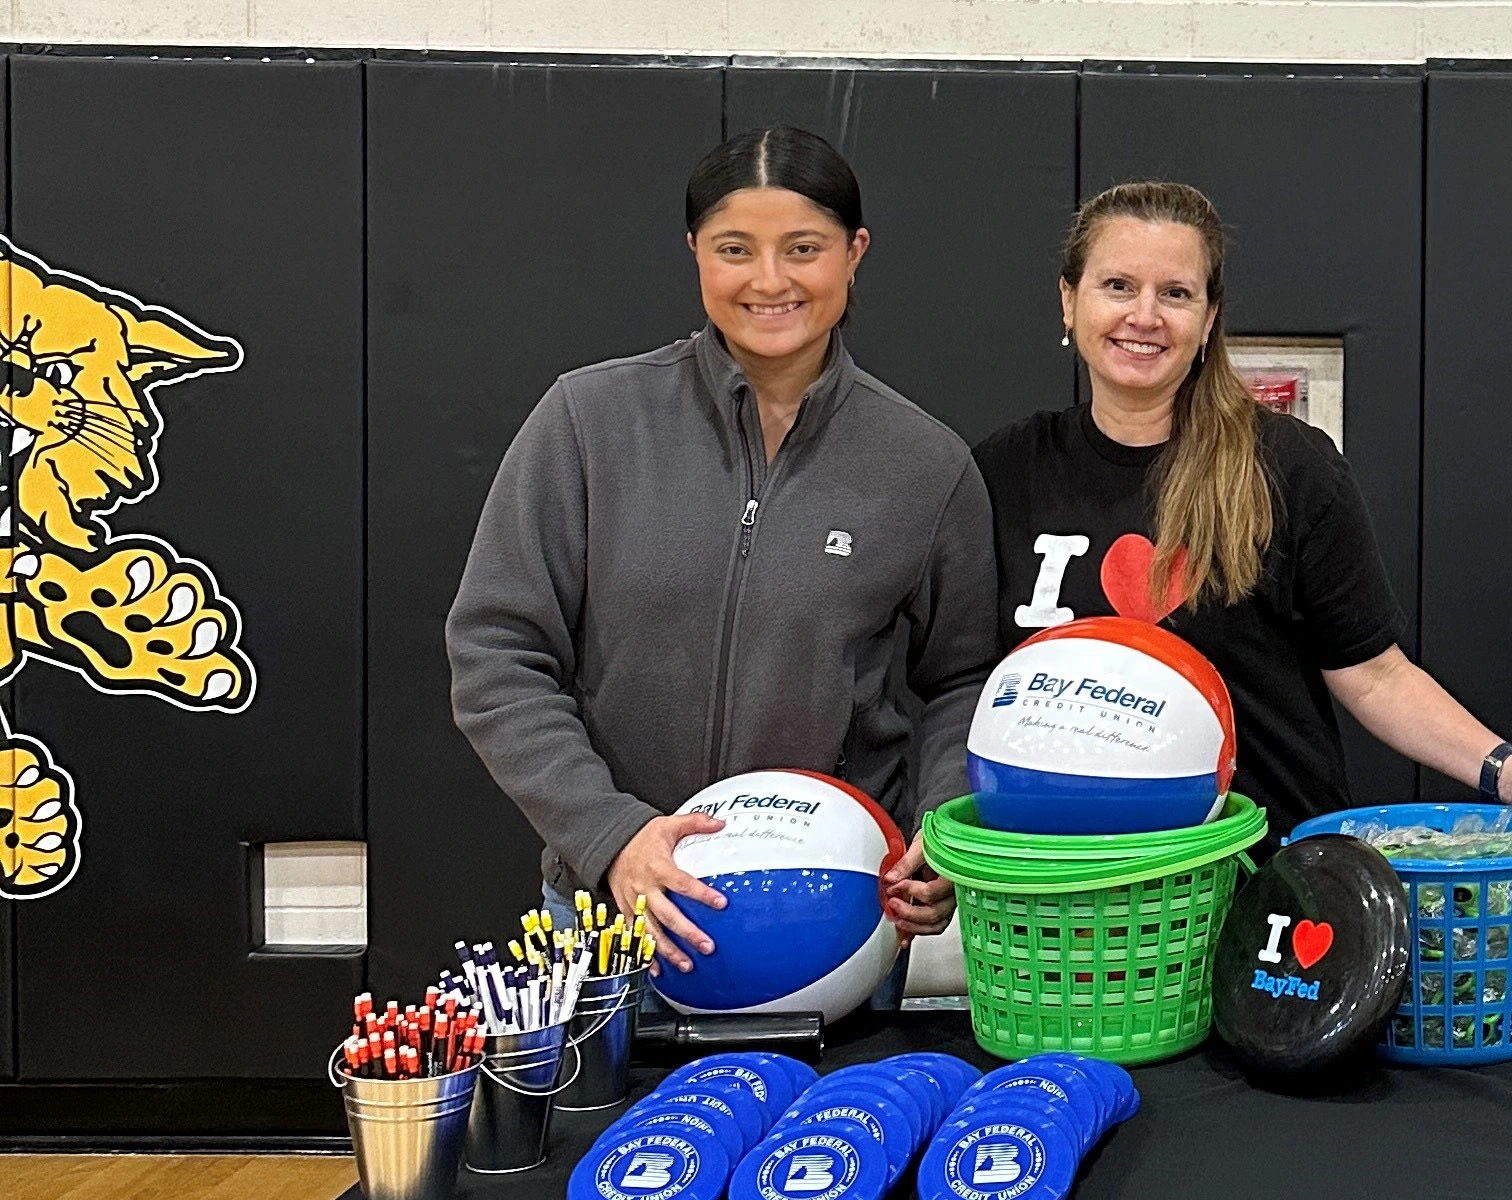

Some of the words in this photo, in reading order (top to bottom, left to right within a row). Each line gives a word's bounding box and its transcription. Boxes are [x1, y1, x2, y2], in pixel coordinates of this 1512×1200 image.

[1014, 533, 1090, 628] I
[1027, 672, 1075, 699] Bay
[1075, 678, 1167, 718] Federal
[1022, 699, 1085, 713] CREDIT
[1100, 710, 1157, 734] UNION
[728, 794, 821, 815] Federal
[754, 814, 811, 828] UNION
[1257, 913, 1292, 964] I
[1251, 968, 1322, 1001] BayFed
[816, 1107, 871, 1125] FEDERAL
[617, 1138, 643, 1156] BAY
[647, 1135, 697, 1159] FEDERAL
[774, 1139, 800, 1159] BAY
[802, 1135, 854, 1159] FEDERAL
[958, 1131, 981, 1150] BAY
[985, 1125, 1036, 1148] FEDERAL
